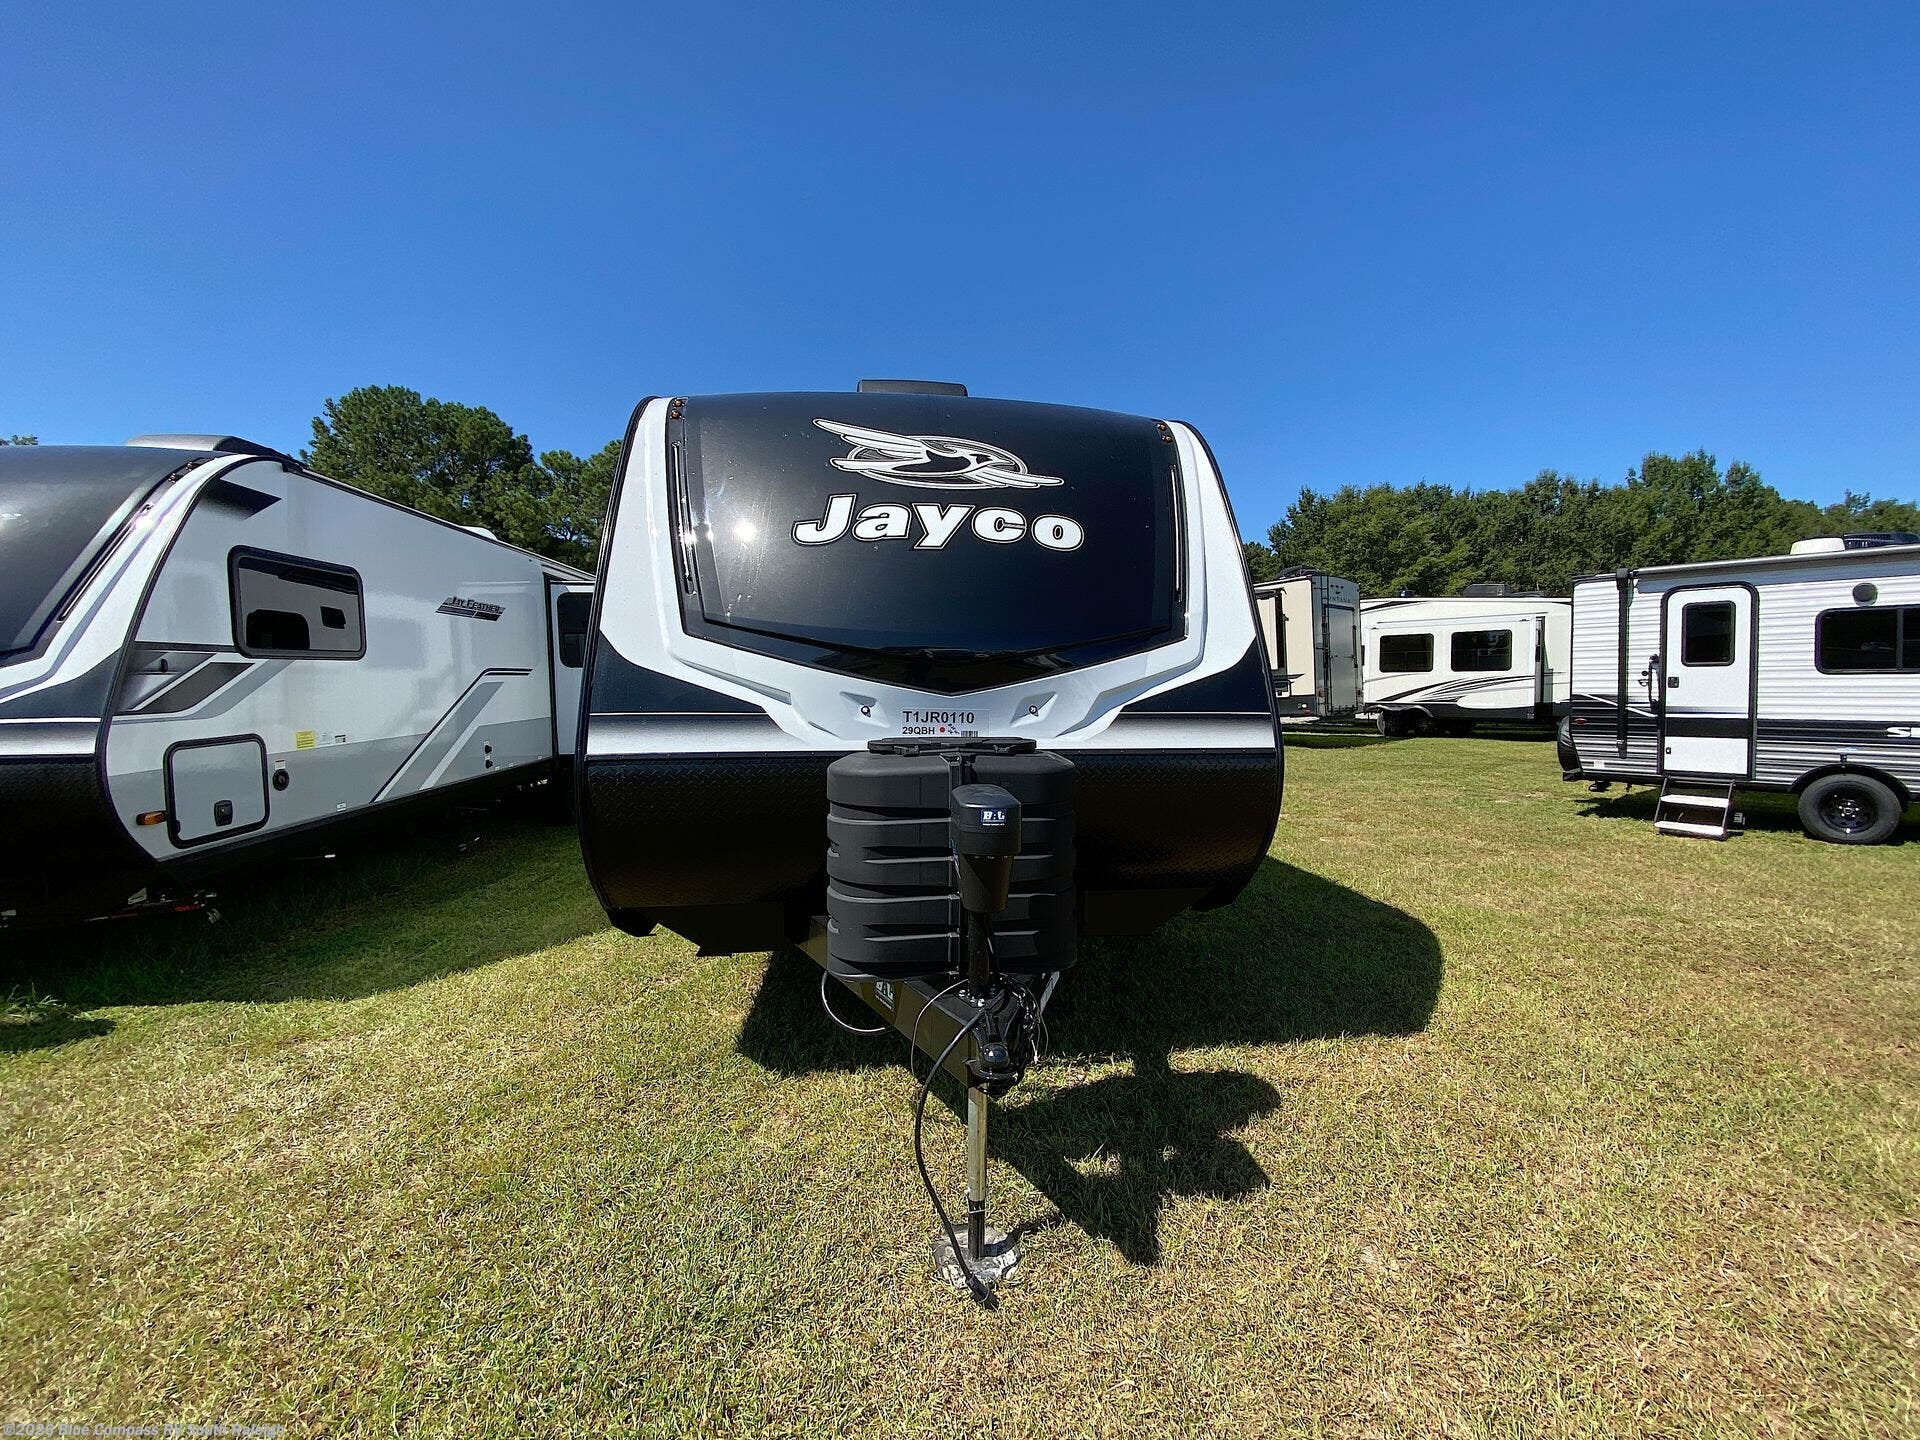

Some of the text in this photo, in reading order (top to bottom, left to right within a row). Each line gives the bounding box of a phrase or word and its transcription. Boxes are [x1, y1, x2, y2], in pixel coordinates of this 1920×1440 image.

[791, 493, 1085, 551] Jayco
[902, 710, 975, 724] T1JR0110
[902, 726, 935, 735] 29QBH
